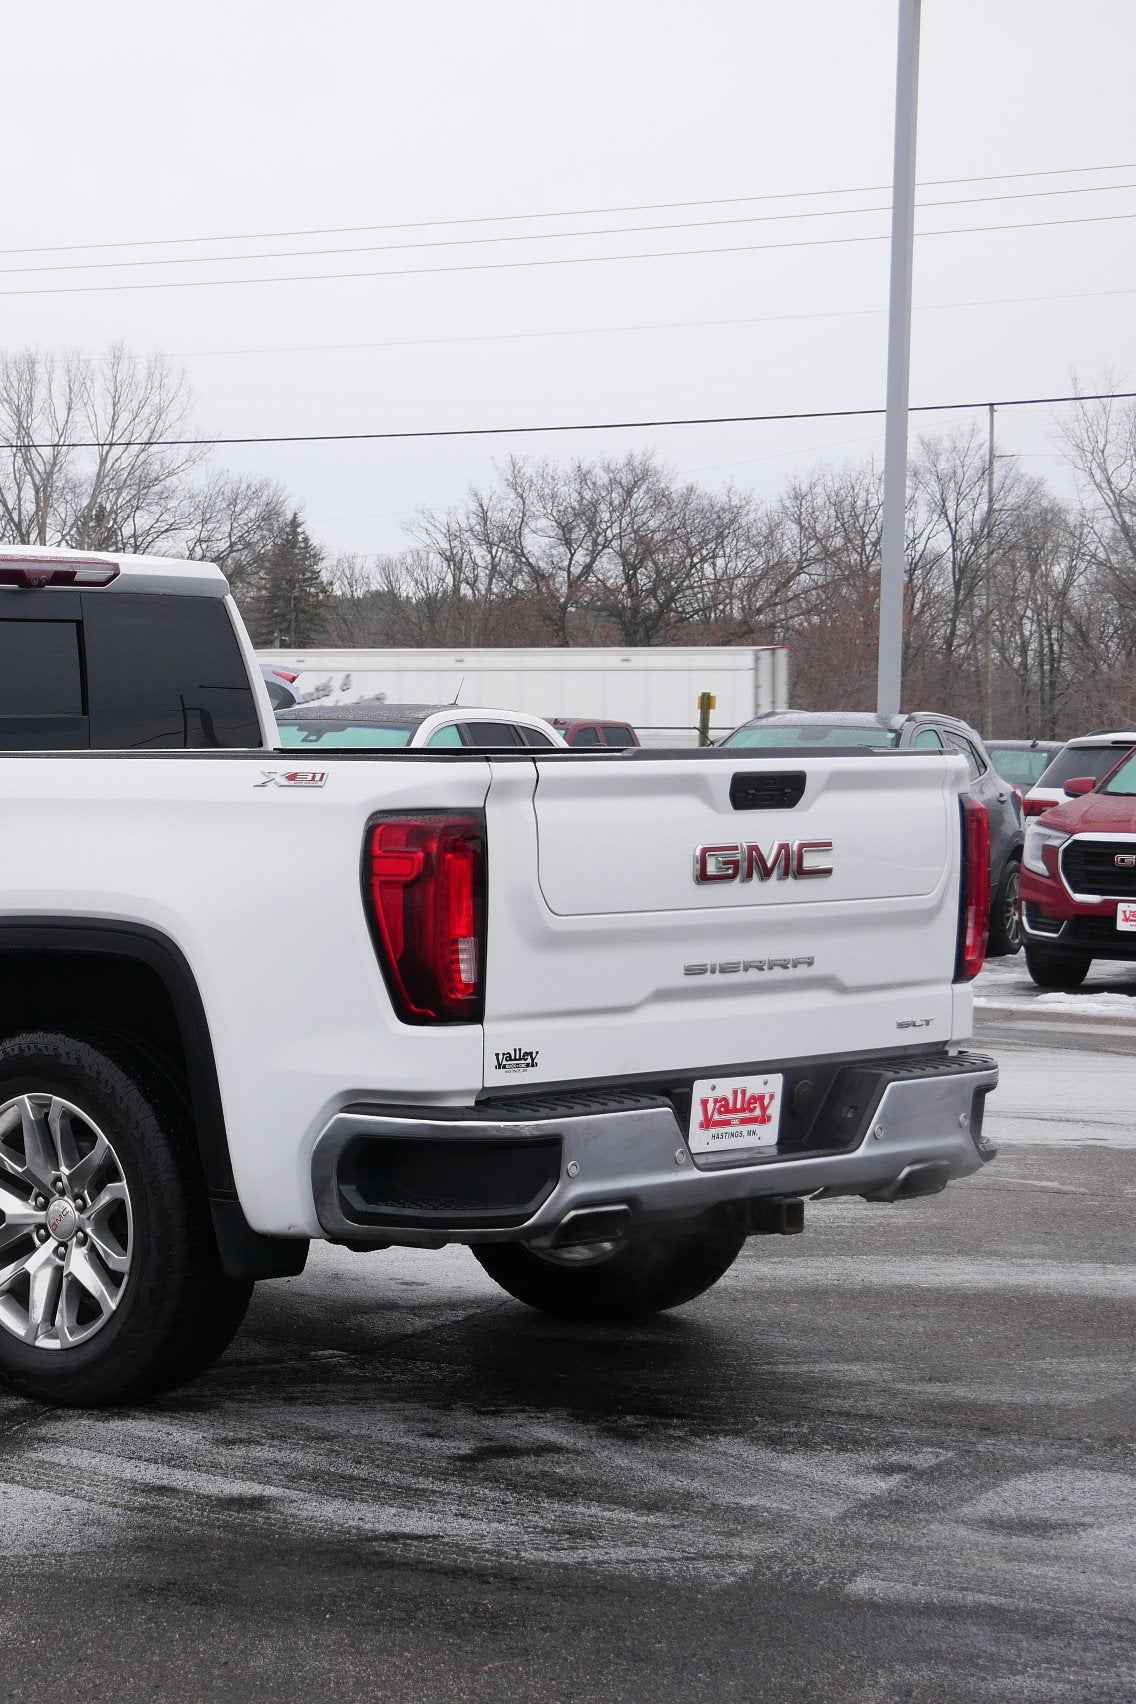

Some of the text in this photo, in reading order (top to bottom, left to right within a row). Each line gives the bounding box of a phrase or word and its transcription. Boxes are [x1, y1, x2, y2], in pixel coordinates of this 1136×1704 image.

[693, 838, 834, 886] GMC
[683, 954, 815, 976] SIERRA
[896, 1017, 935, 1029] SLT
[494, 1047, 540, 1070] Valley
[699, 1087, 775, 1131] Valley
[711, 1130, 745, 1141] HASTINGS,
[50, 1206, 70, 1232] GMC
